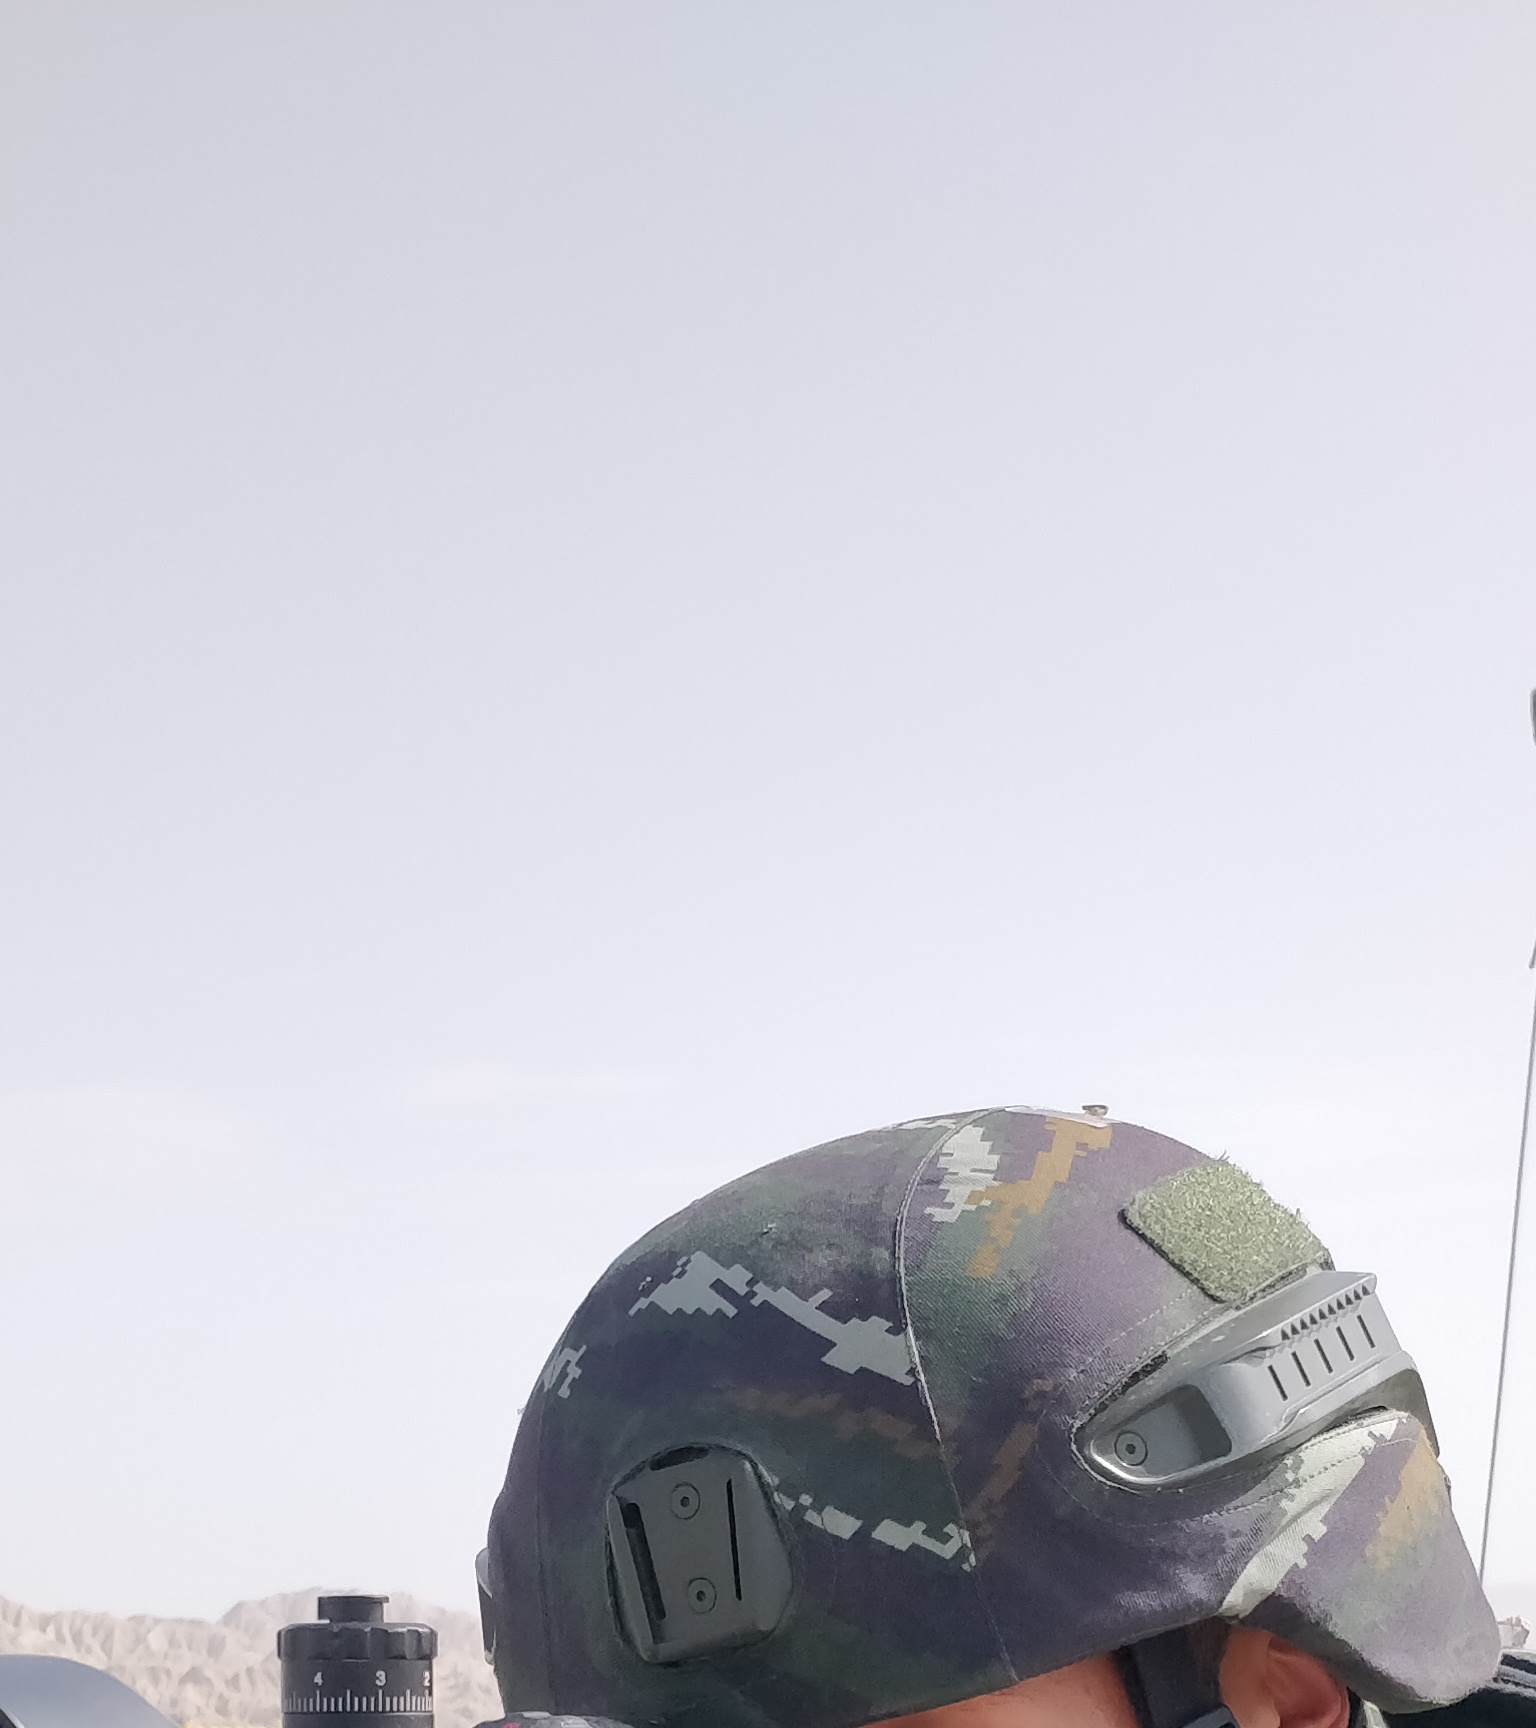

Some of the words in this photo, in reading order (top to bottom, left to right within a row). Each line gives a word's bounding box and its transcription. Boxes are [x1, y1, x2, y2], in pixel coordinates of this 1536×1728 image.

[314, 1671, 323, 1686] 4
[375, 1670, 386, 1686] 3
[423, 1671, 430, 1686] 2
